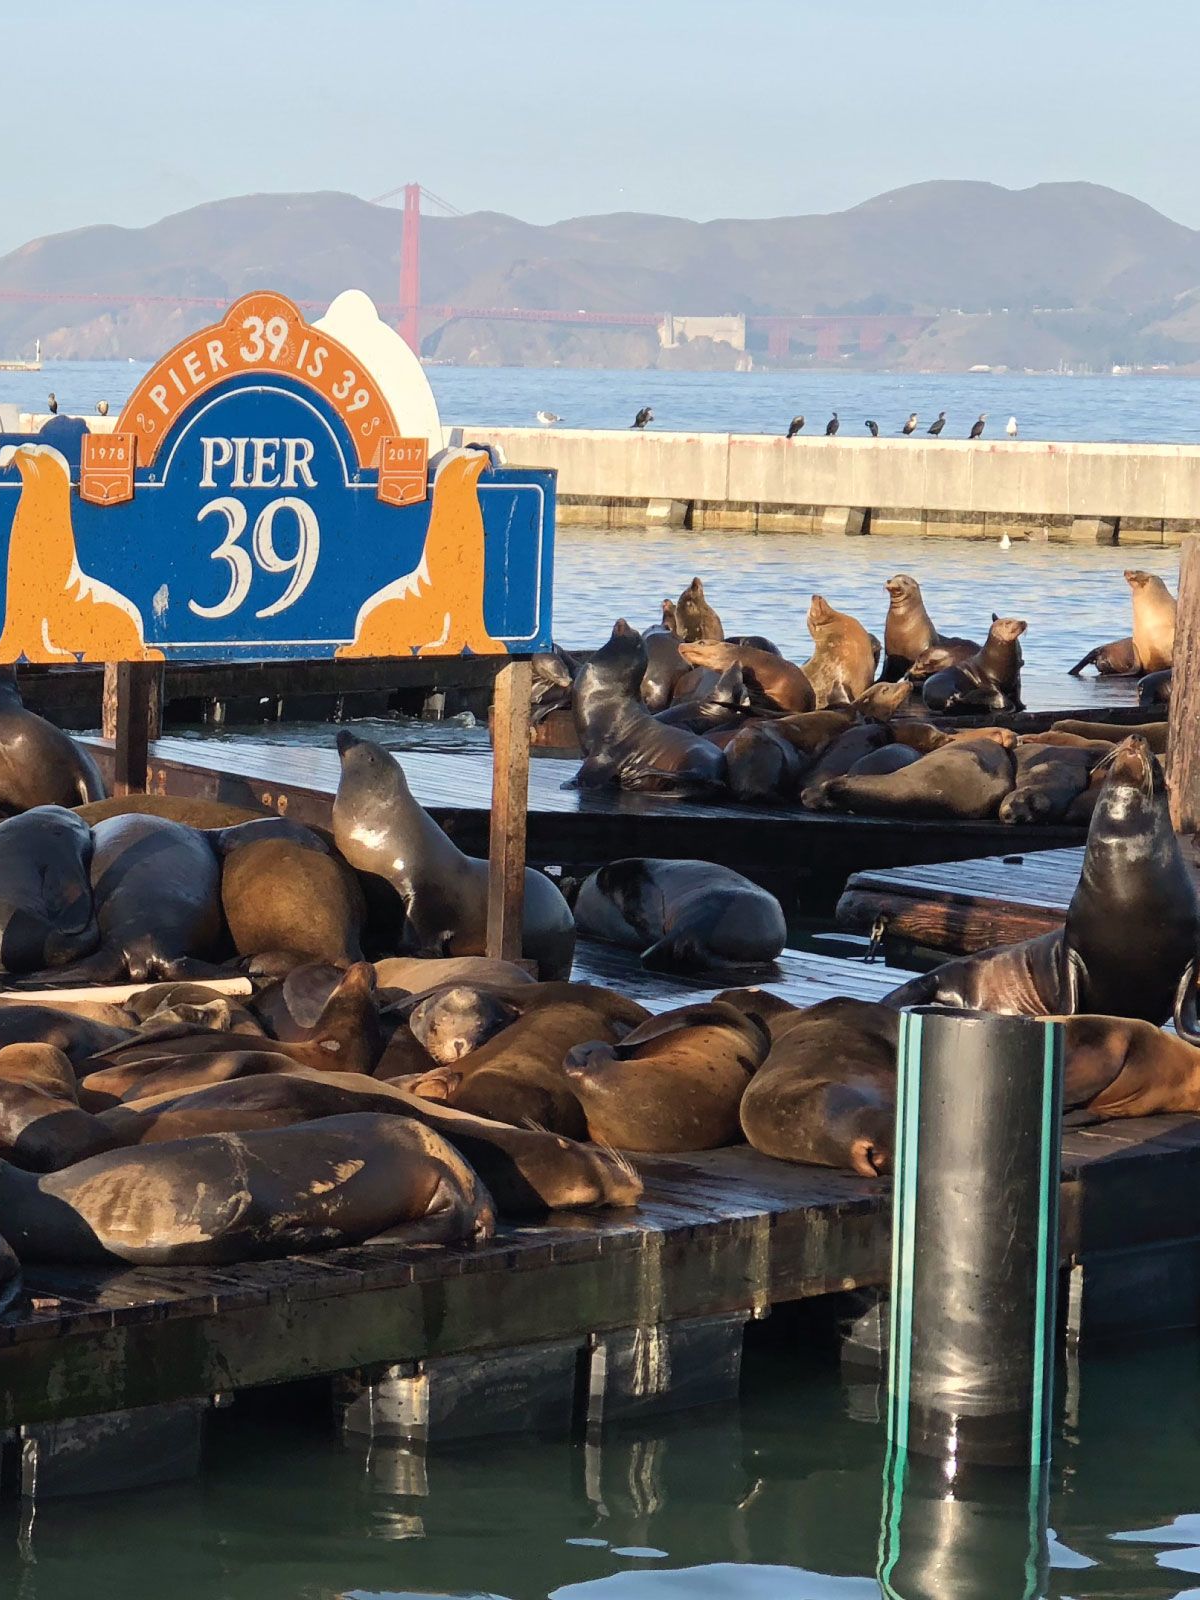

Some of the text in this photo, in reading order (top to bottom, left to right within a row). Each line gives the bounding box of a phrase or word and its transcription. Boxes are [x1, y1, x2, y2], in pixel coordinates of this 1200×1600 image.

[148, 316, 370, 415] PIER 39 IS 39
[90, 447, 125, 460] 1978
[199, 437, 318, 488] PIER
[388, 448, 422, 461] 2017
[188, 496, 321, 619] 39
